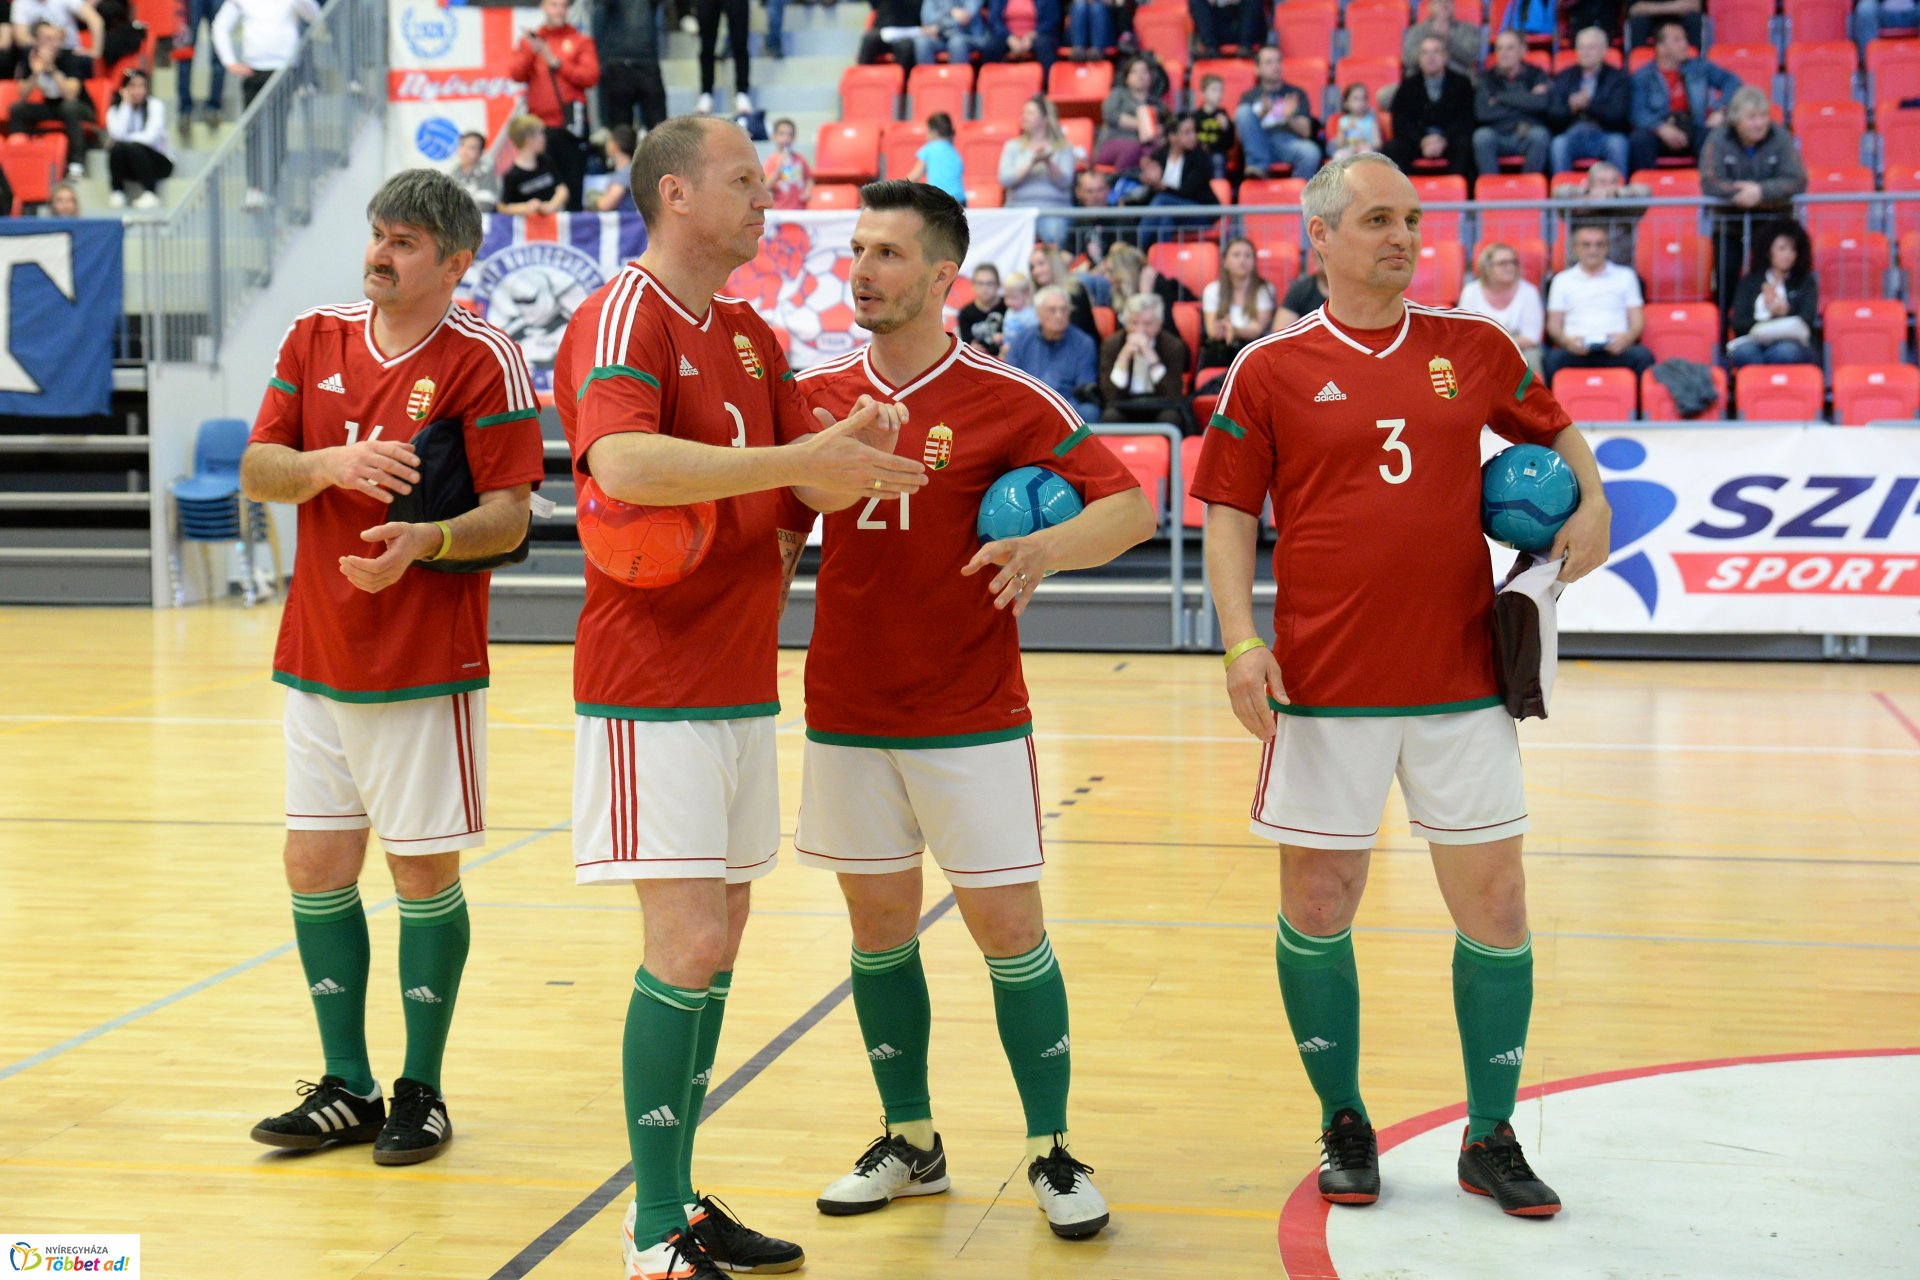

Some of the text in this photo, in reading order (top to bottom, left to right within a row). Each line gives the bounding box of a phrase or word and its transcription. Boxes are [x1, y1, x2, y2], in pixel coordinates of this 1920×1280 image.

[679, 367, 699, 376] adidas
[317, 382, 346, 394] adidas
[1314, 393, 1347, 402] adidas
[1375, 418, 1413, 485] 3
[1686, 474, 1920, 540] SZI
[1705, 556, 1919, 592] SPORT
[868, 1050, 903, 1061] didas
[1041, 1047, 1070, 1058] adida
[1489, 1056, 1523, 1066] adida
[638, 1118, 680, 1127] adidas
